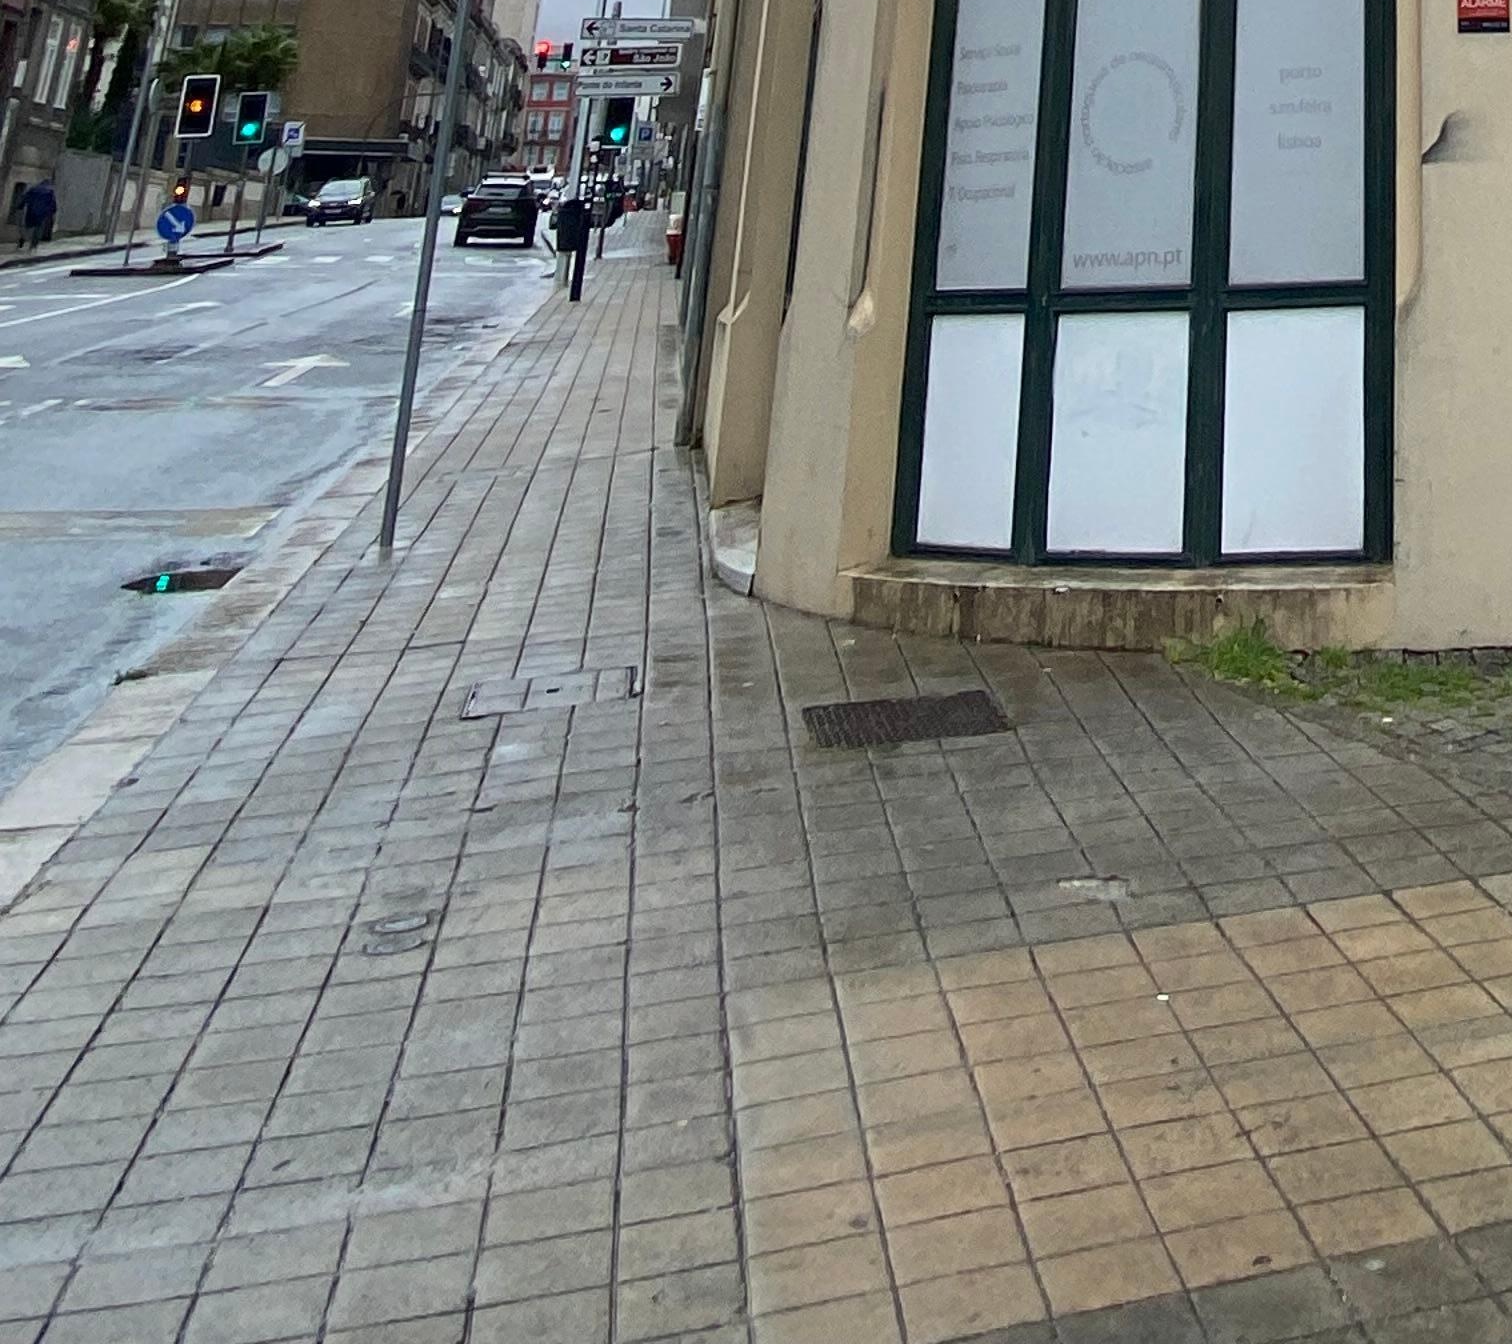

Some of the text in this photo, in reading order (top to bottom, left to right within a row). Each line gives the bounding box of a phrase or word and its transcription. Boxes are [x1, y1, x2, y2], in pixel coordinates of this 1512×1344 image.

[632, 54, 677, 63] São João
[1073, 250, 1182, 270] www.apn.pt
